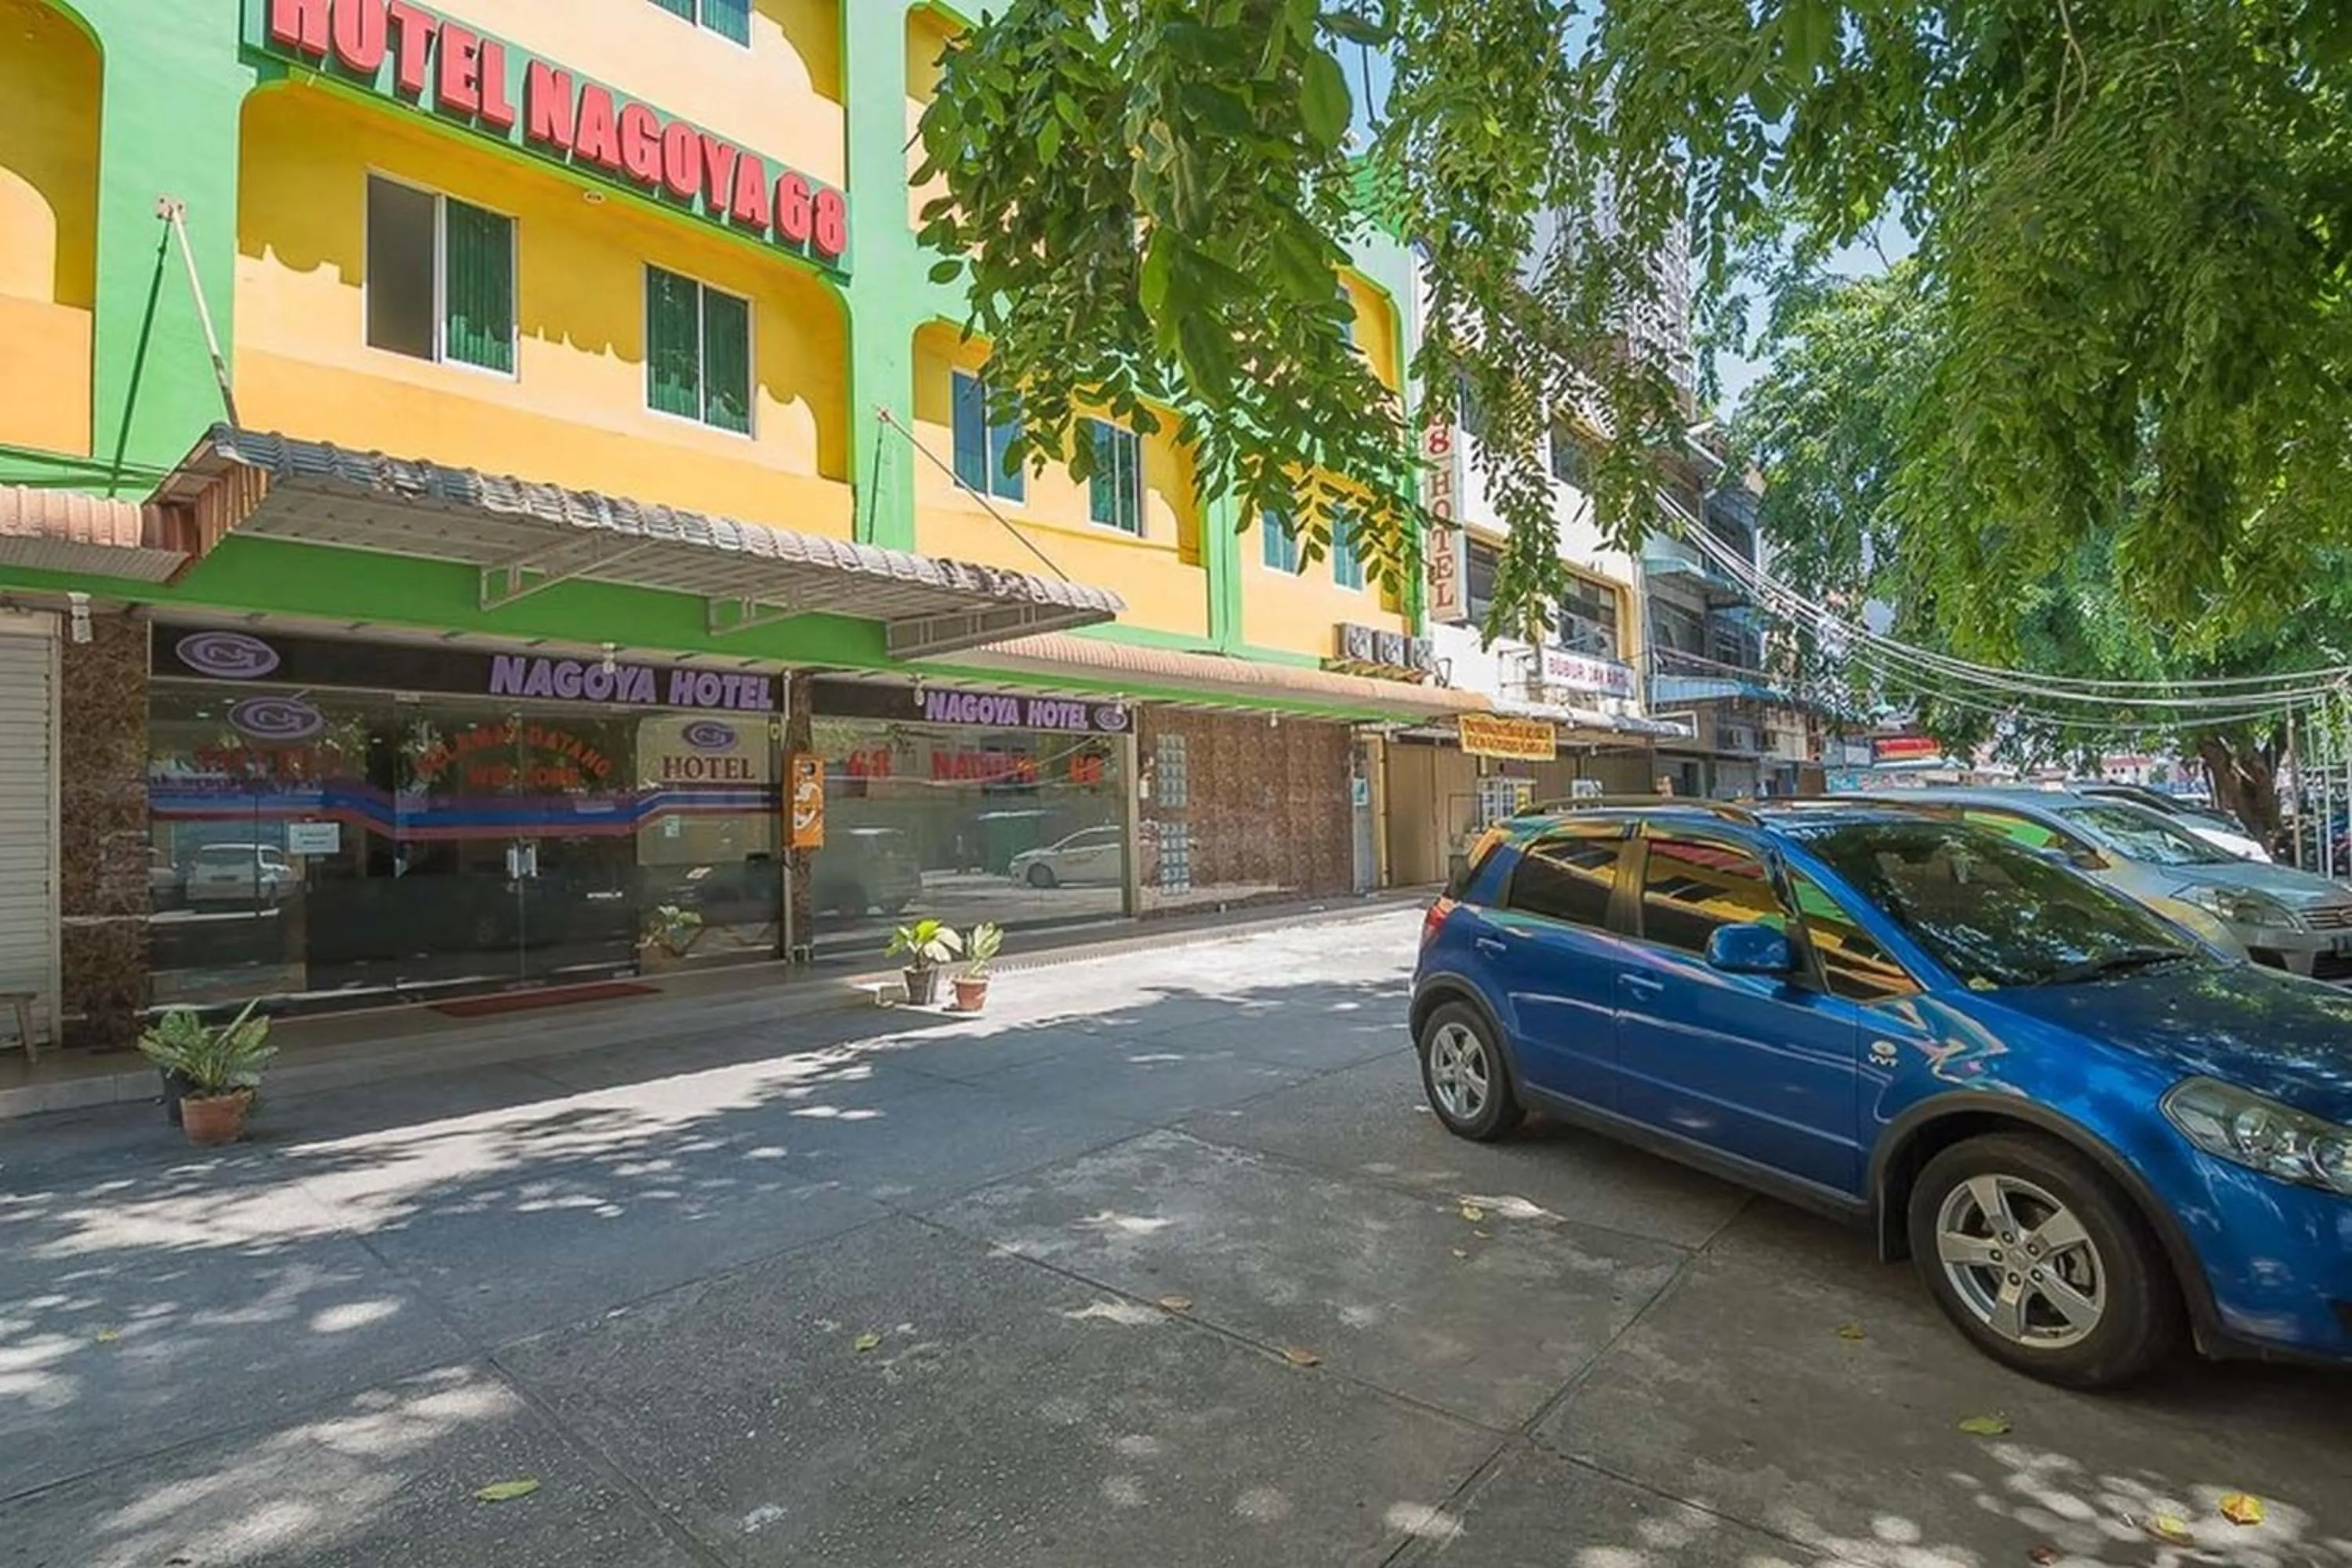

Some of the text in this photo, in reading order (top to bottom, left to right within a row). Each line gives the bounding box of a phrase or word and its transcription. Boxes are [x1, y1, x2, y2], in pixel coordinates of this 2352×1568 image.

[521, 59, 769, 227] NAGOYA
[774, 169, 847, 257] 68
[1430, 473, 1454, 608] HOTEL
[490, 655, 773, 710] NAGOYA HOTEL
[925, 691, 1020, 726] NAGOYA
[1026, 700, 1089, 730] HOTEL
[662, 757, 755, 780] HOTEL
